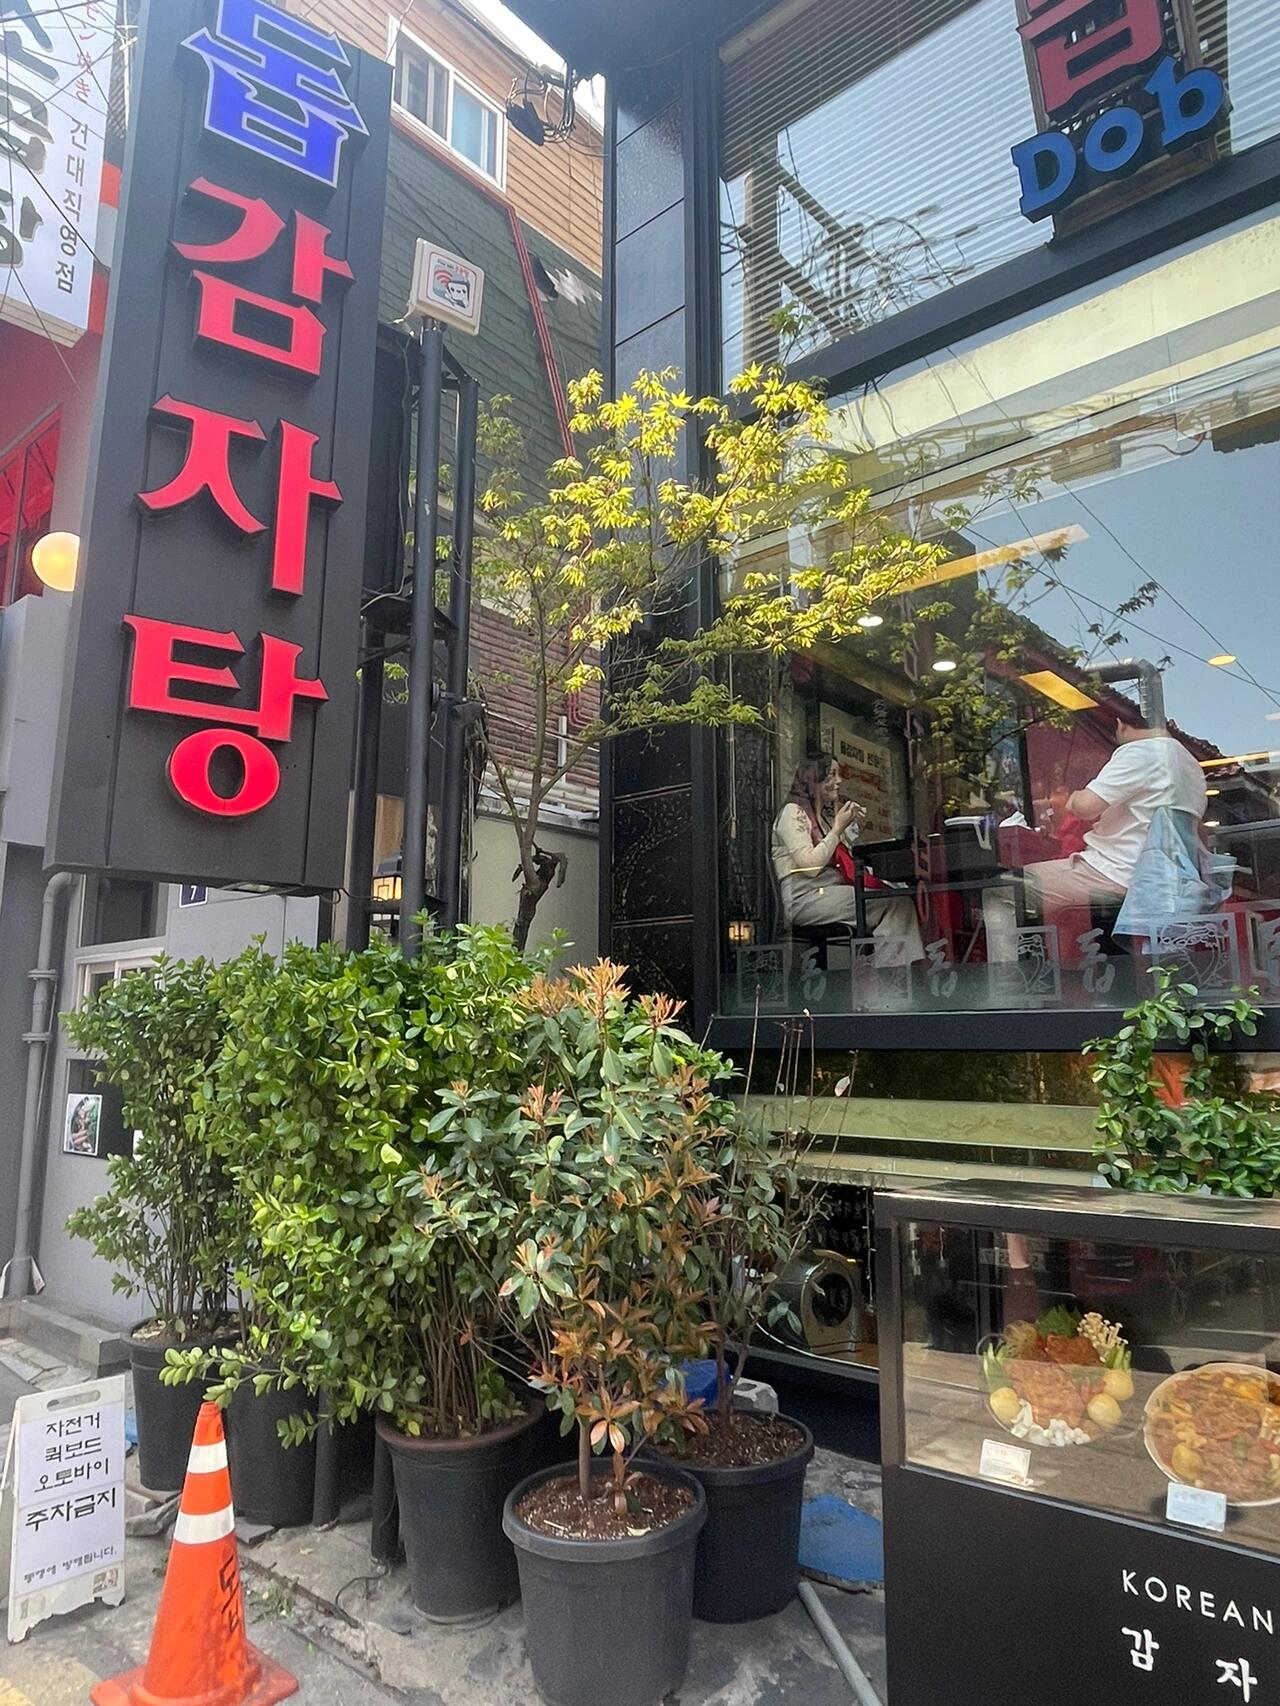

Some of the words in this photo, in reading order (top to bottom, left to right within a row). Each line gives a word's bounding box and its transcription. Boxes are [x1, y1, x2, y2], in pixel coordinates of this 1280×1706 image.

[1010, 55, 1224, 215] Dob
[55, 117, 88, 294] 건대직영점
[45, 1437, 102, 1462] 퀵보드
[46, 1412, 100, 1437] 자전거
[34, 1458, 109, 1493] 오토바이
[1121, 1568, 1273, 1634] KOREAN
